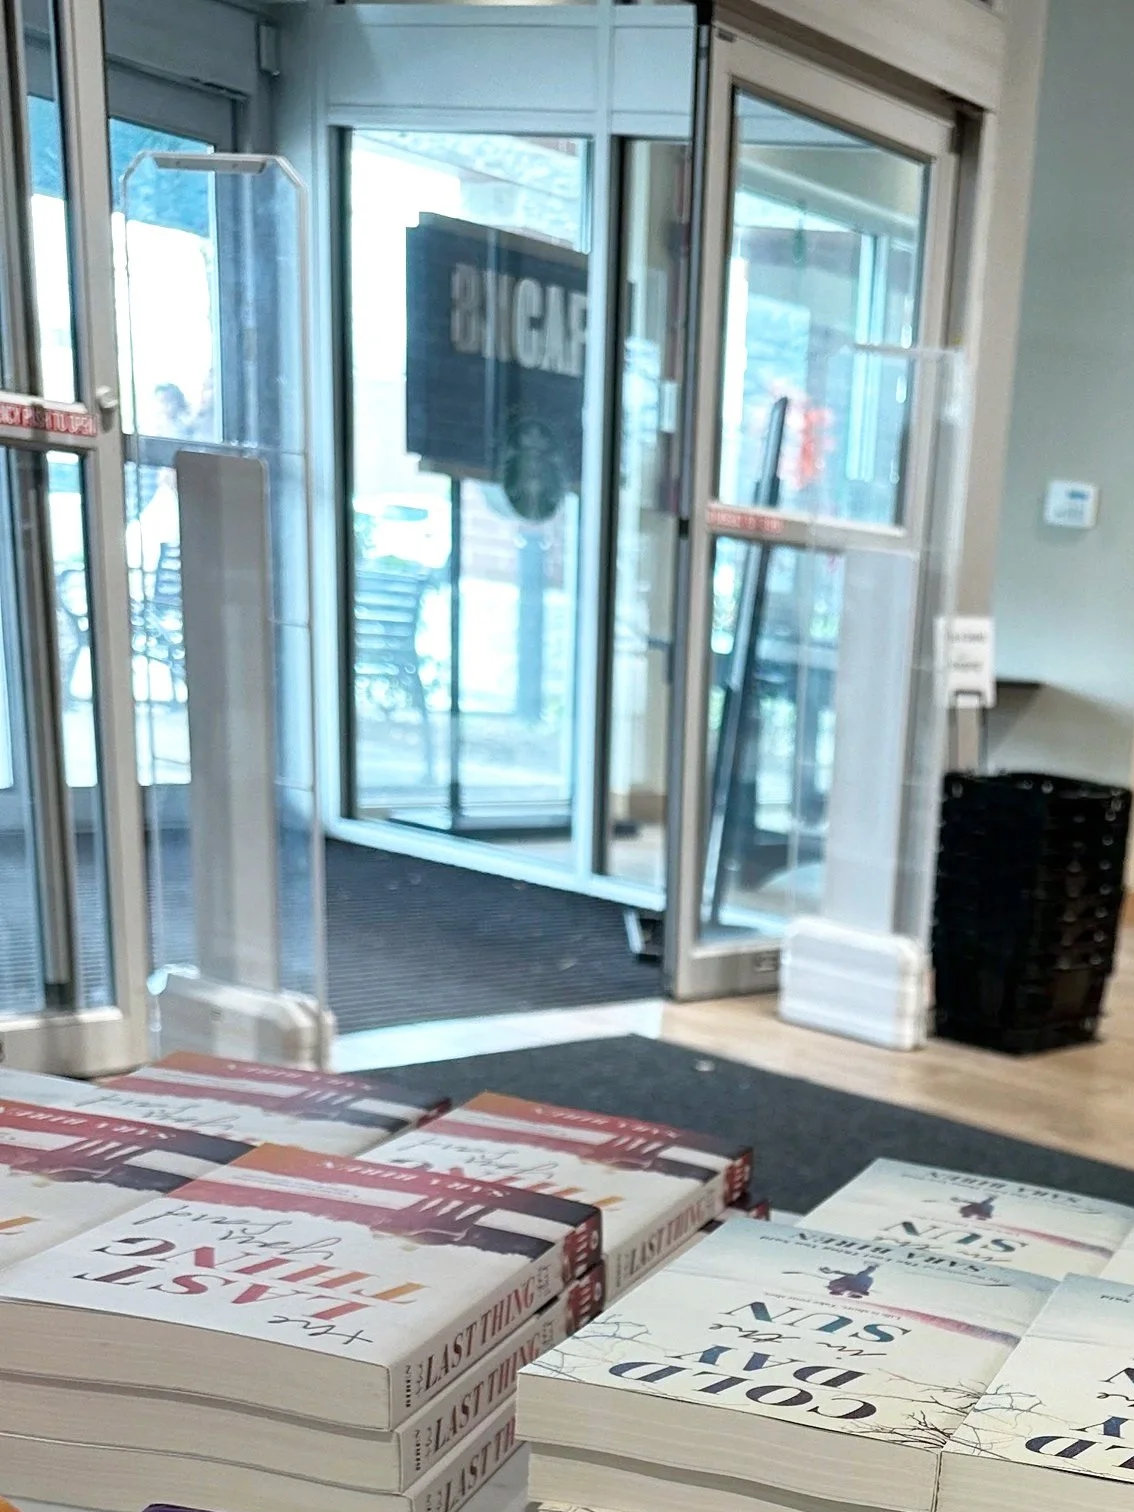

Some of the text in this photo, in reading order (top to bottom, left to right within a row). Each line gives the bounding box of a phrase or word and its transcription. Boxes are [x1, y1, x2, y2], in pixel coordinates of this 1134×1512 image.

[791, 1231, 988, 1273] SARA BIREN
[881, 1221, 1028, 1254] SUN
[73, 1265, 374, 1321] LAST
[92, 1237, 428, 1305] THING
[425, 1324, 475, 1393] LAST
[479, 1276, 536, 1345] THING
[709, 1322, 801, 1344] the
[719, 1301, 912, 1343] SUN
[607, 1360, 878, 1420] COLD
[668, 1344, 866, 1389] DAY
[434, 1382, 483, 1456] LAST
